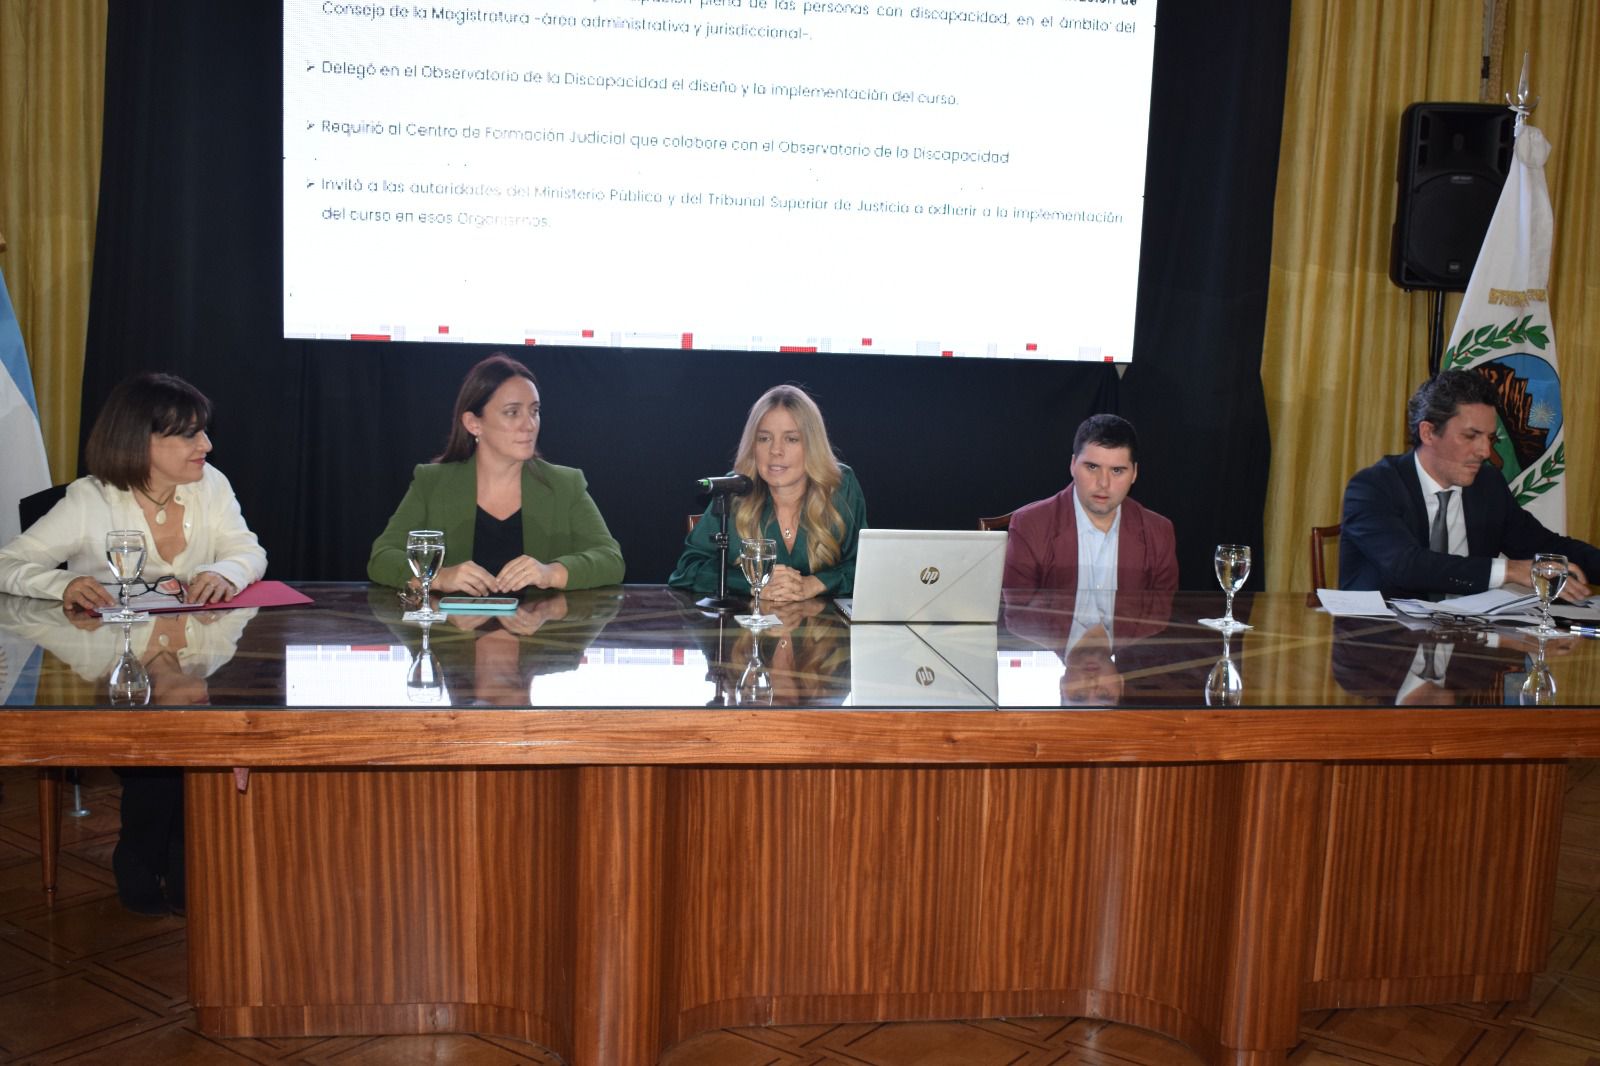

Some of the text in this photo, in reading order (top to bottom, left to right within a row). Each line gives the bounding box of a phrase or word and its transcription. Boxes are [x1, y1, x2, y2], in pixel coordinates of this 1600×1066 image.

[321, 2, 385, 22] Consejo
[389, 6, 409, 19] de
[413, 6, 427, 20] la
[431, 7, 530, 26] Magistratura
[581, 15, 689, 33] administrativa
[693, 25, 702, 37] y
[775, 0, 796, 11] las
[804, 2, 869, 15] personas
[877, 6, 903, 17] con
[911, 7, 1010, 26] discapacidad,
[1016, 16, 1034, 26] en
[1040, 16, 1053, 28] el
[1115, 20, 1136, 34] del
[321, 61, 959, 105] Delegó en el Observatorio de la Discapacidad el diseño y la implementación del curso.
[321, 120, 1010, 164] Requirió al Centro de Formación Judicial que colabore con el Observatorio de la Discapacidad
[321, 178, 1124, 224] Invitó a las autoridades del Ministerio Público y del Tribunal Superior de Justicia a adherir a la implementación
[321, 207, 345, 220] del
[350, 210, 391, 222] curso
[396, 212, 414, 222] en
[418, 213, 453, 224] esos
[920, 566, 940, 585] hp
